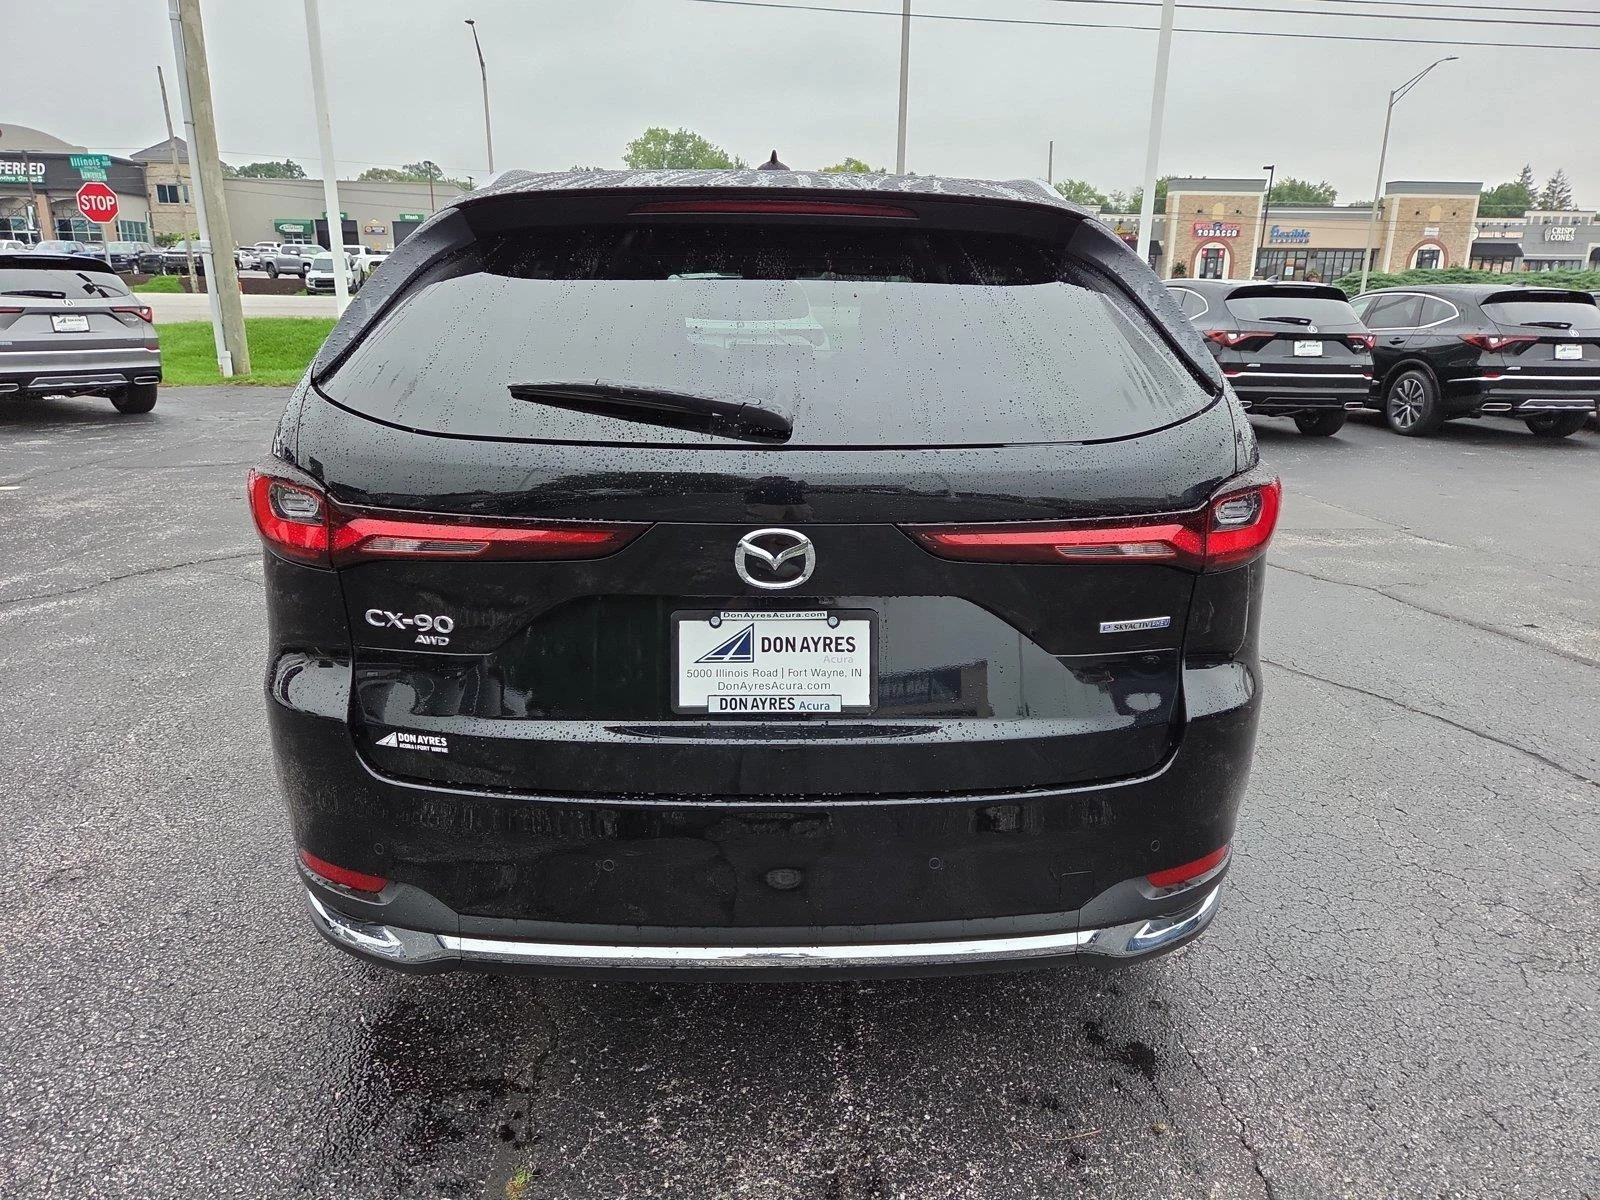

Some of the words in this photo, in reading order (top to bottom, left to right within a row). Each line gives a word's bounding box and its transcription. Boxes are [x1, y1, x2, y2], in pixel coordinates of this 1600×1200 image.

[70, 156, 101, 167] Illinois
[80, 195, 115, 211] STOP
[1197, 229, 1239, 237] TOBACCO
[1551, 226, 1577, 235] CRISPY
[1550, 233, 1575, 242] CONES
[723, 611, 827, 619] DonAyresAcura.com
[365, 608, 455, 634] CX-90
[414, 634, 450, 646] AWD
[761, 636, 796, 653] DON
[799, 636, 857, 653] AYRES
[823, 655, 854, 664] Acura
[686, 669, 712, 678] 5000
[715, 669, 749, 678] Illinois
[752, 668, 778, 678] Road
[788, 668, 808, 678] Fort
[810, 668, 848, 680] Wayne,
[851, 668, 862, 677] IN
[717, 681, 831, 692] DonAyresAcura.com
[719, 697, 748, 711] DON
[750, 697, 795, 711] AYRES
[798, 701, 830, 711] Acura
[397, 732, 416, 743] DON
[417, 735, 448, 747] AYRES
